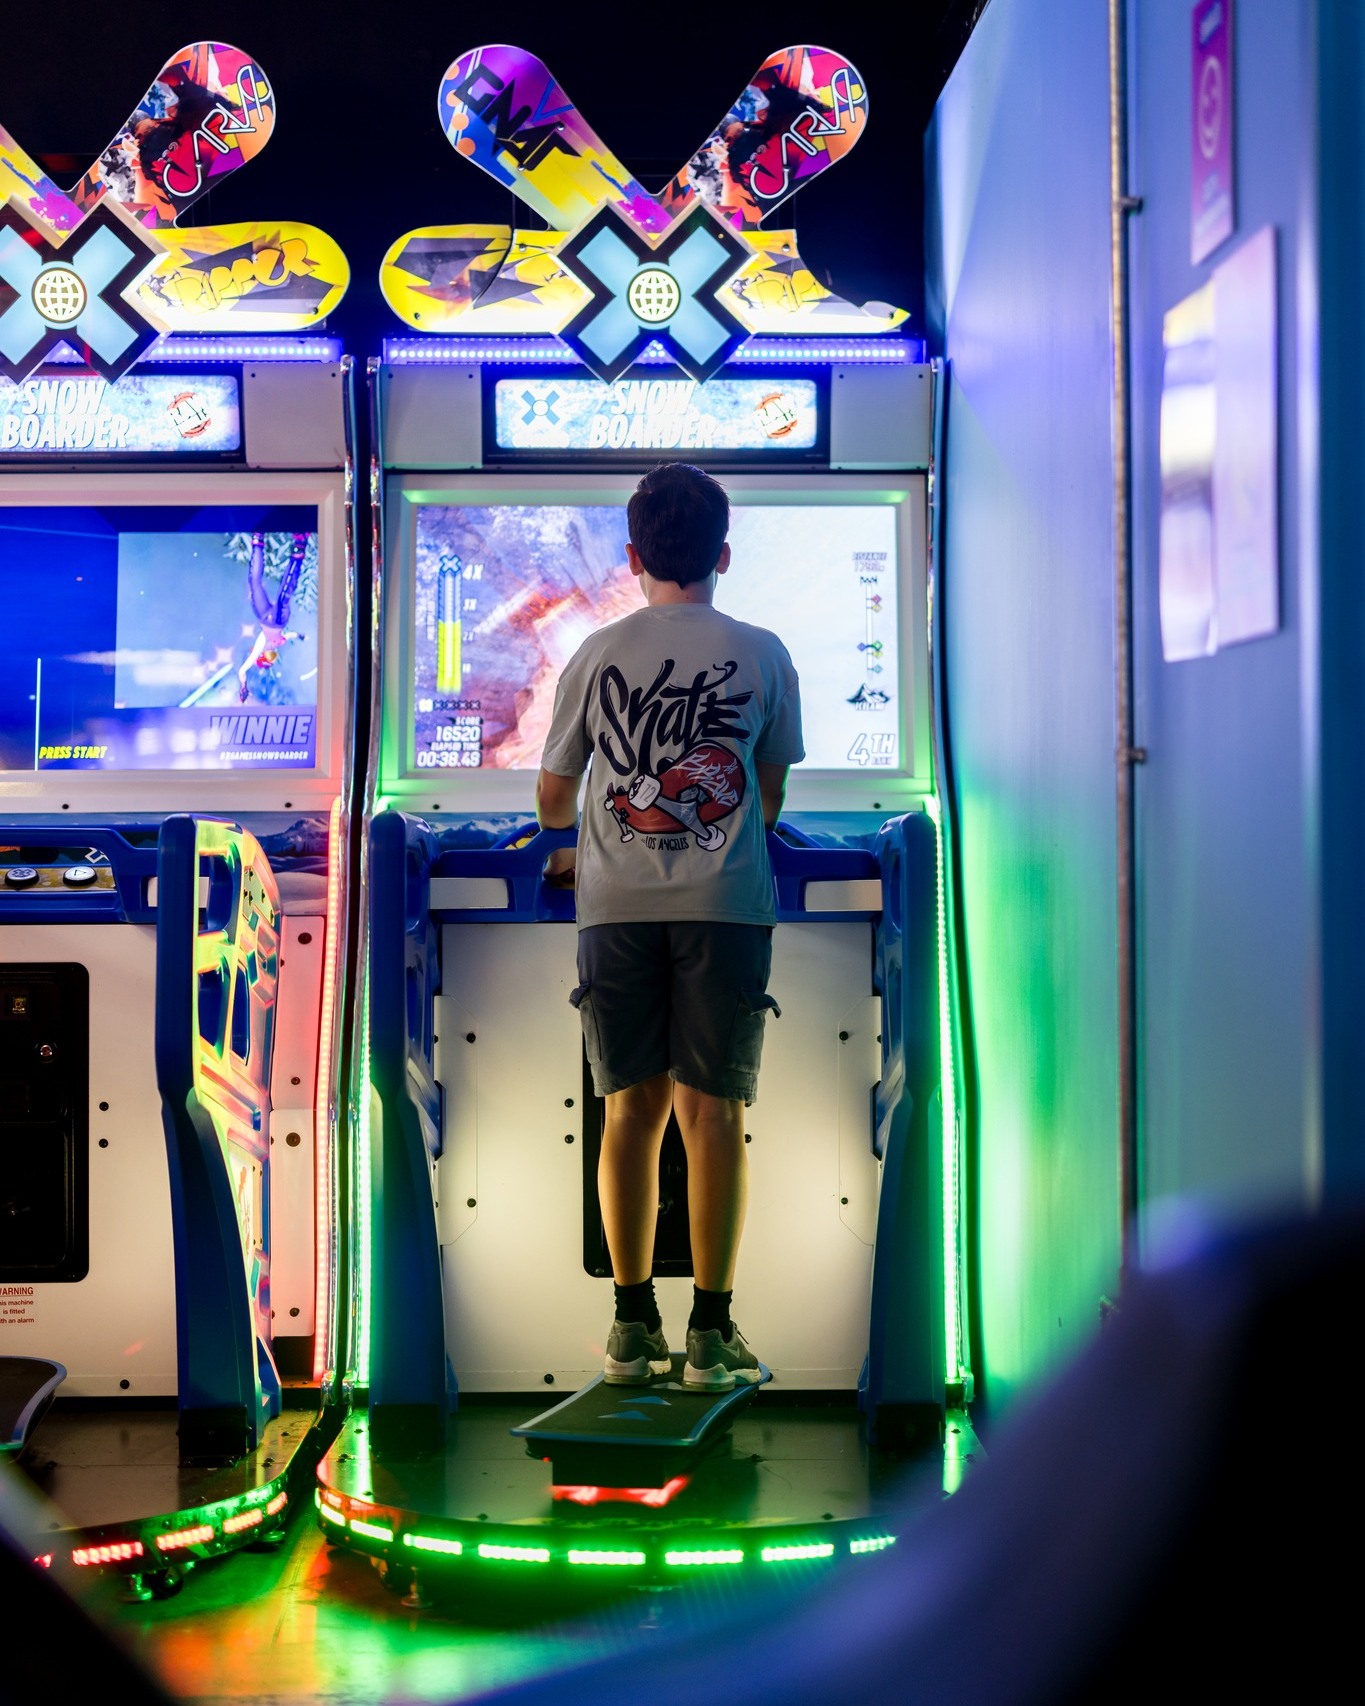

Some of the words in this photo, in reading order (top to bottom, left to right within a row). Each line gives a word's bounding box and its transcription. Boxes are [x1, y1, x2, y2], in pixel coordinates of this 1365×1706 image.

[23, 380, 107, 415] SNOW
[611, 381, 698, 416] SNOW
[1, 414, 130, 448] BOARDER
[588, 415, 717, 449] BOARDER
[462, 564, 483, 580] 4X
[210, 715, 312, 745] WINNIE
[436, 726, 481, 741] 16520
[39, 746, 72, 759] PRESS
[72, 746, 107, 758] START
[417, 752, 481, 767] 00:38.48
[645, 836, 657, 849] LOS
[658, 838, 690, 850] ANGELES
